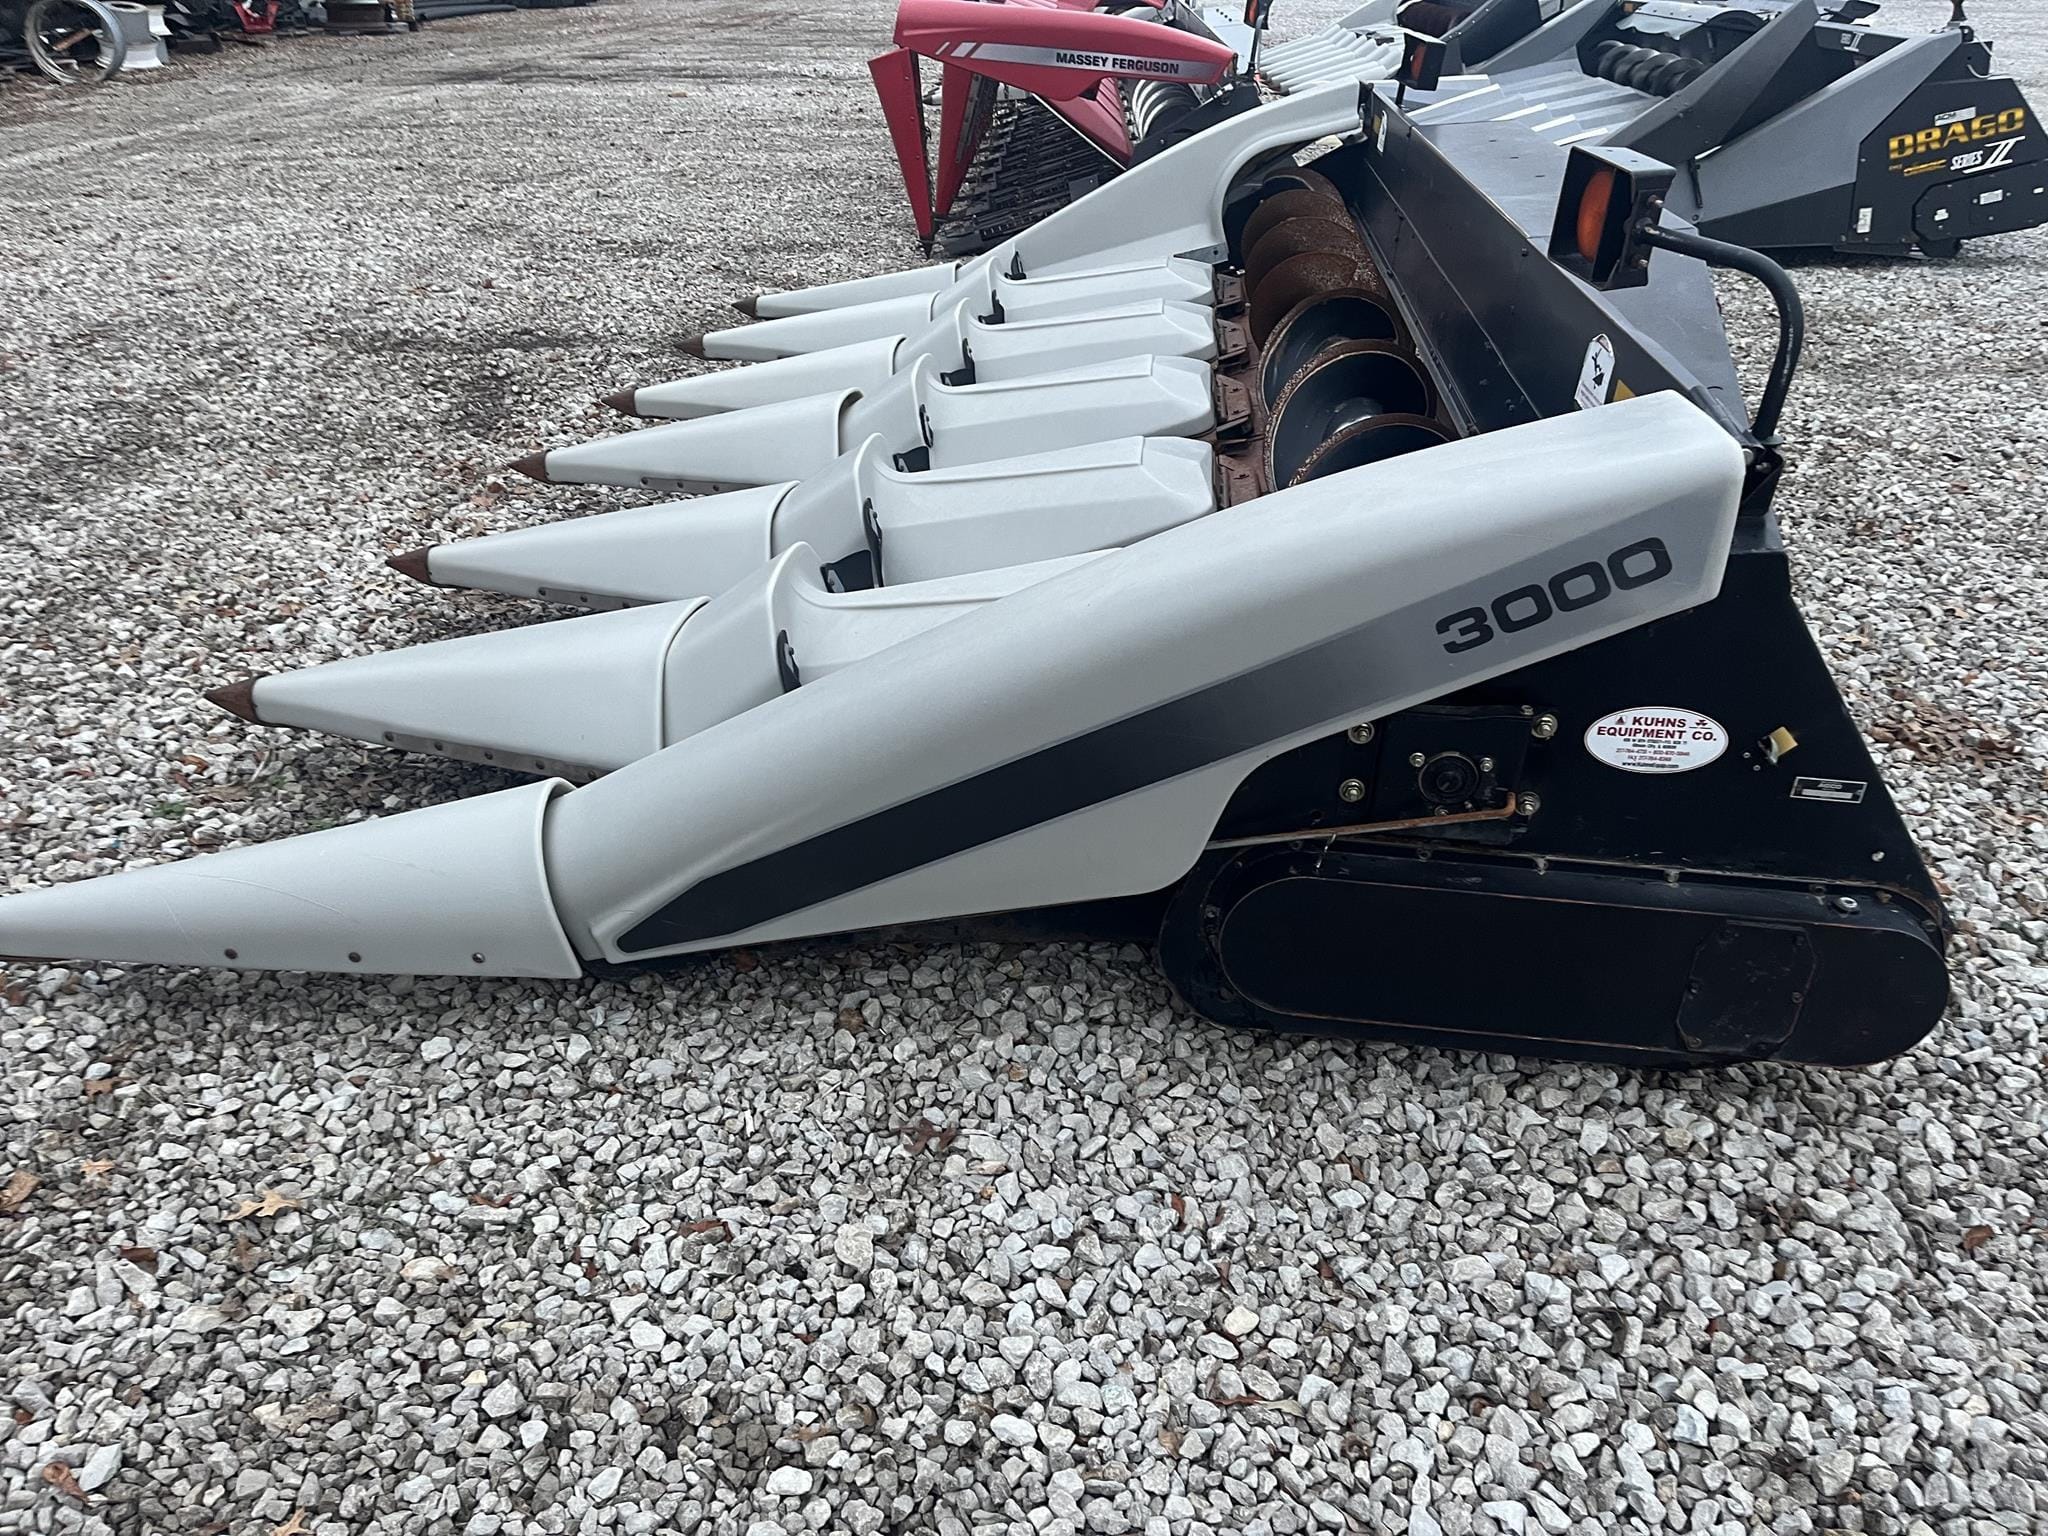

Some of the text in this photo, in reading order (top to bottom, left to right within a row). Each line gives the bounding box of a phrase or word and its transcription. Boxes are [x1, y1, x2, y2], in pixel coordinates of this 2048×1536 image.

[1056, 52, 1179, 74] MASSEY FERGUSON
[1889, 108, 2025, 160] DRAGO
[1950, 149, 1984, 171] SERIES
[1434, 537, 1673, 654] 3000
[1631, 716, 1687, 728] KUHNS
[1596, 726, 1687, 740] EQUIPMENT
[1691, 731, 1717, 742] CO.
